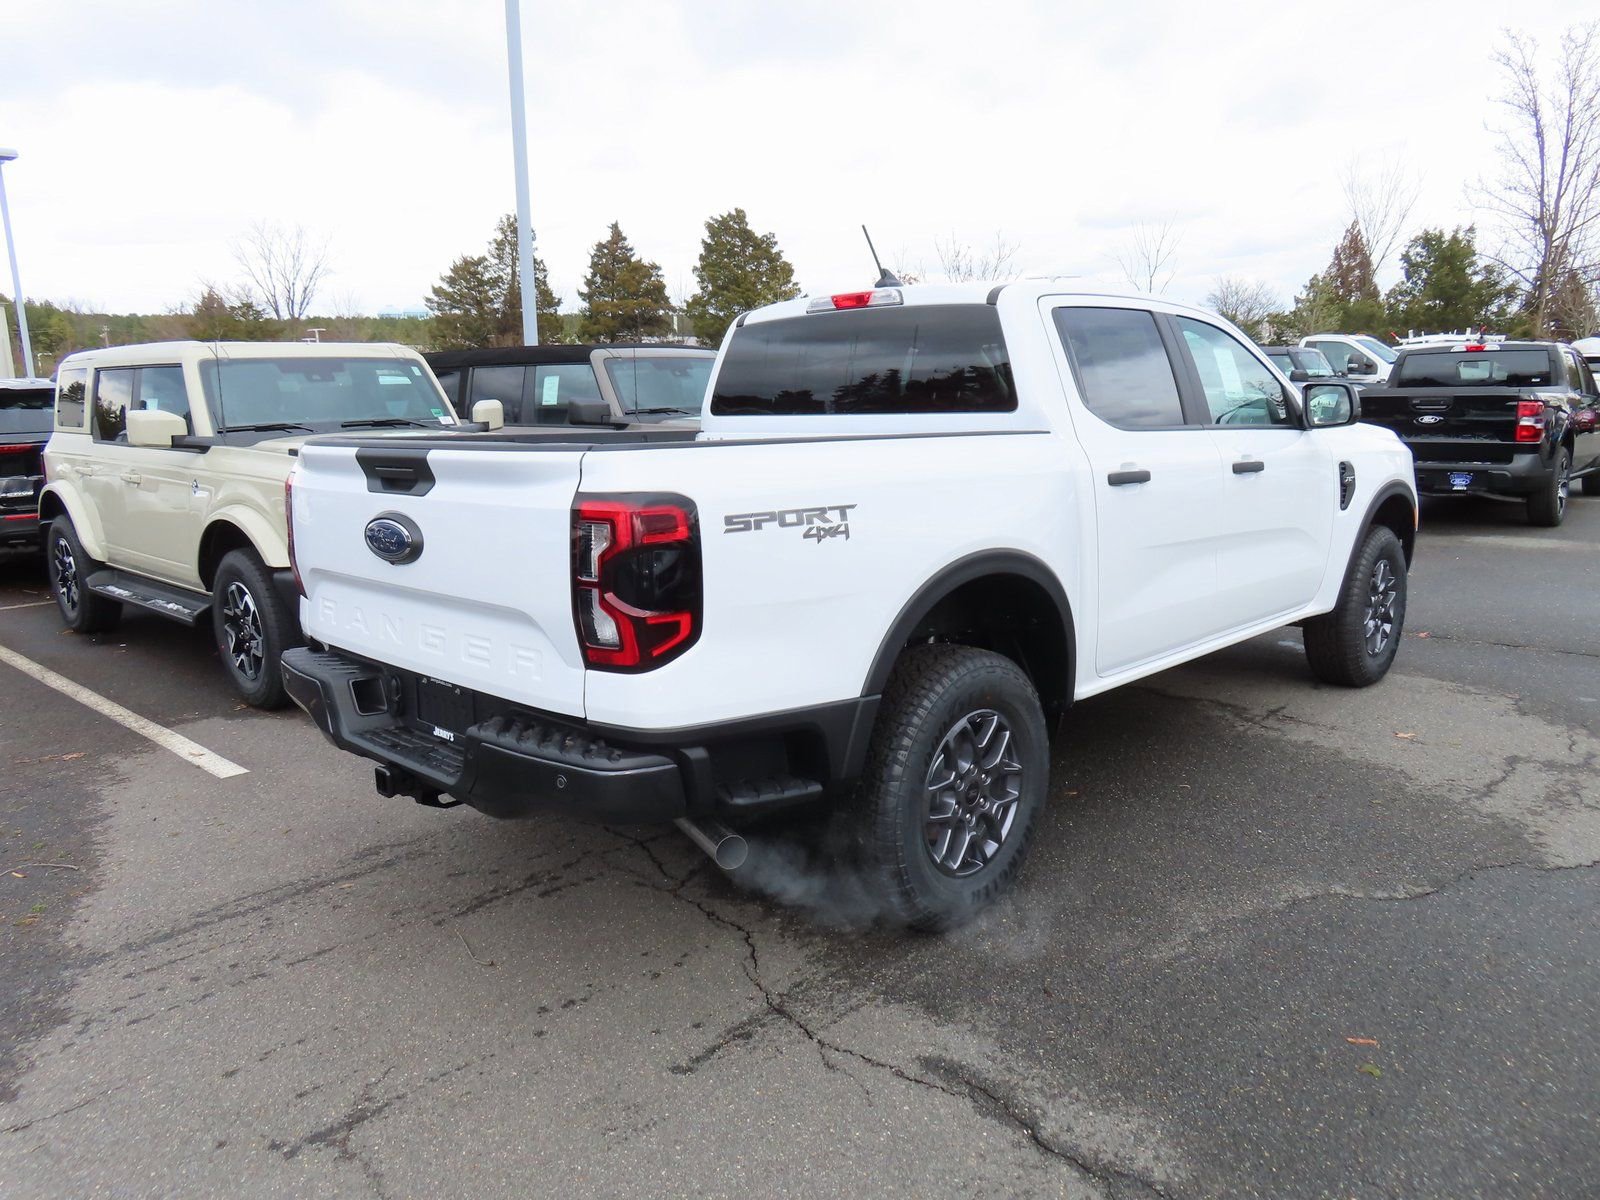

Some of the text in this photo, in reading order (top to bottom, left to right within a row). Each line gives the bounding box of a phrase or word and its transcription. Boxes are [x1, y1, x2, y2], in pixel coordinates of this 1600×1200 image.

[724, 504, 857, 534] SPORT
[803, 523, 850, 544] 4x4
[319, 596, 544, 682] RANGER
